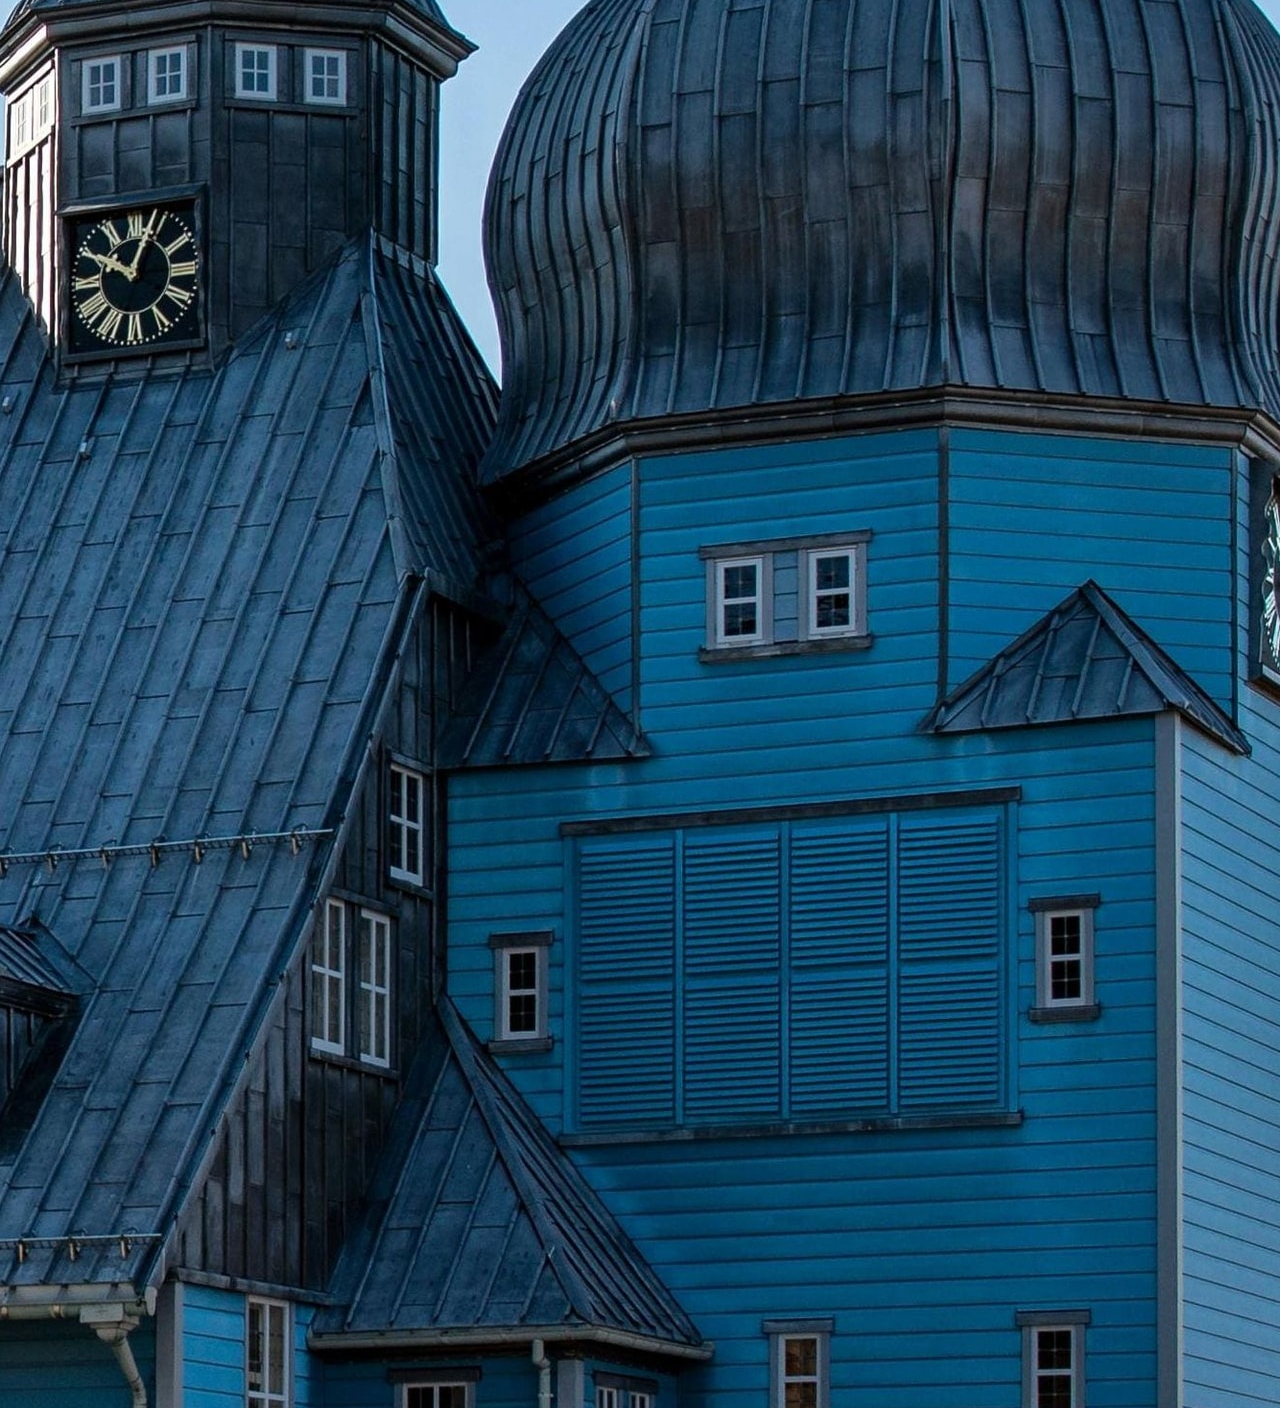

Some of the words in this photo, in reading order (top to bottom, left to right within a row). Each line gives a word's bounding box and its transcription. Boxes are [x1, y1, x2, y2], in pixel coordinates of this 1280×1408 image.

[101, 220, 122, 249] XI
[165, 232, 190, 256] II
[171, 261, 196, 277] III
[75, 274, 100, 291] IX
[79, 291, 109, 325] VIII
[151, 305, 170, 331] V
[97, 308, 124, 340] VII
